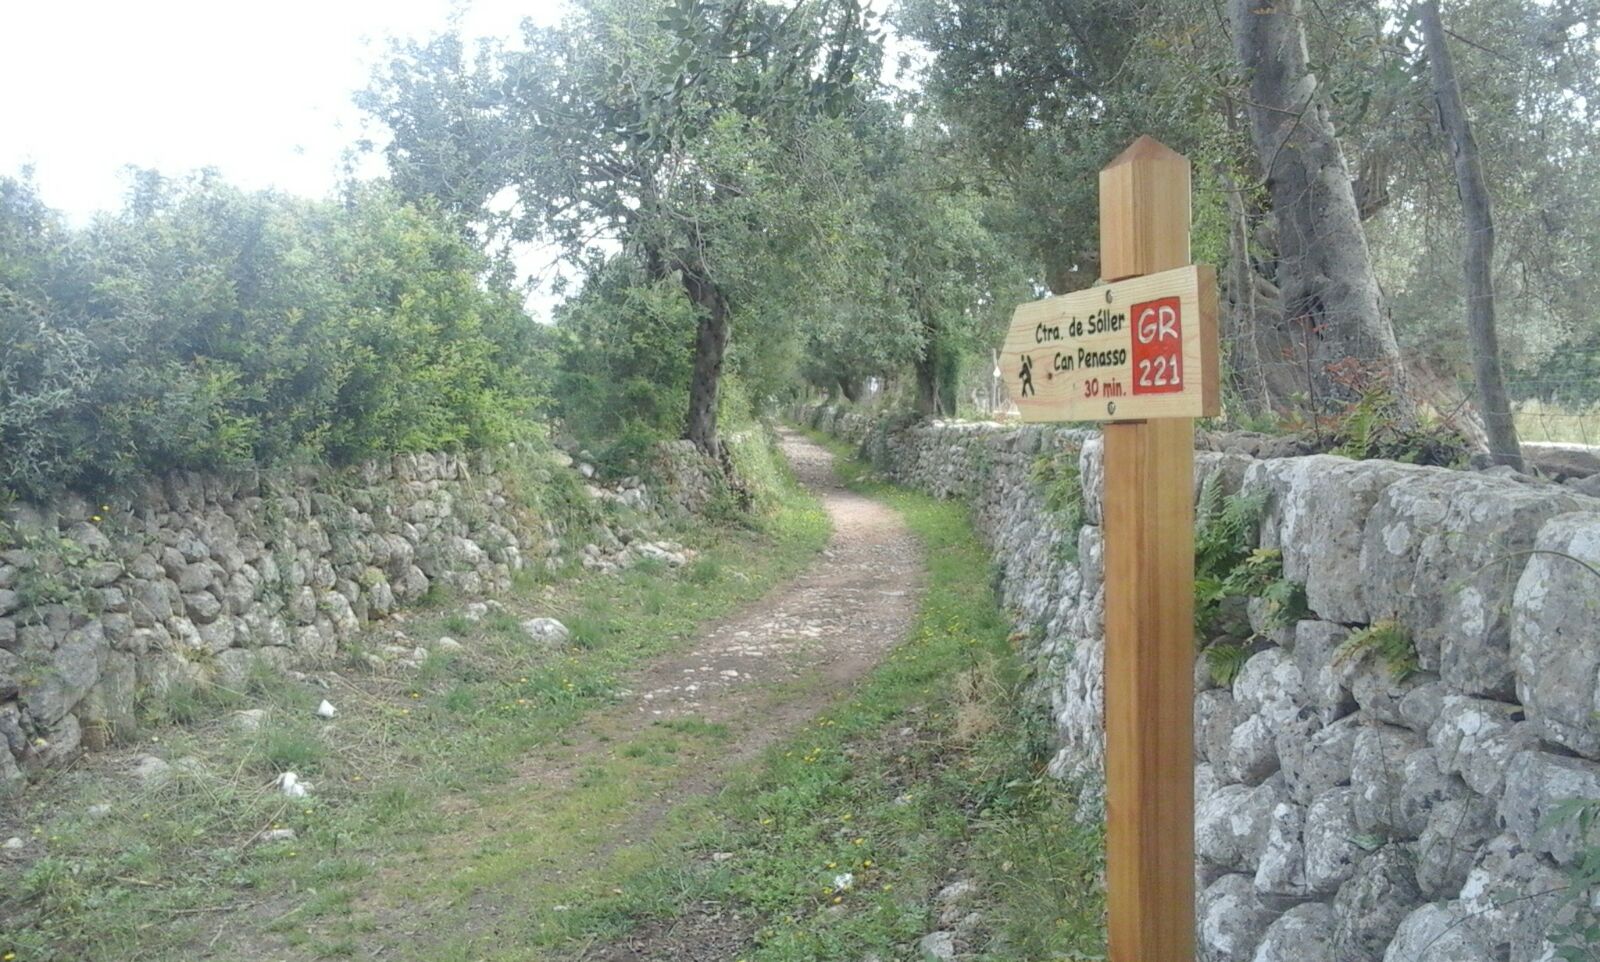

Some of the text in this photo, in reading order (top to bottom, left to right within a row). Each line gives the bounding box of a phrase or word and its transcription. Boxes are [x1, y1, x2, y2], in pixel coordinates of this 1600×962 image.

[1035, 309, 1125, 344] Ctra. de Sóller
[1137, 305, 1178, 344] GR
[1054, 347, 1126, 371] Can Penasso
[1139, 353, 1180, 387] 221
[1084, 377, 1127, 398] 30 min.
